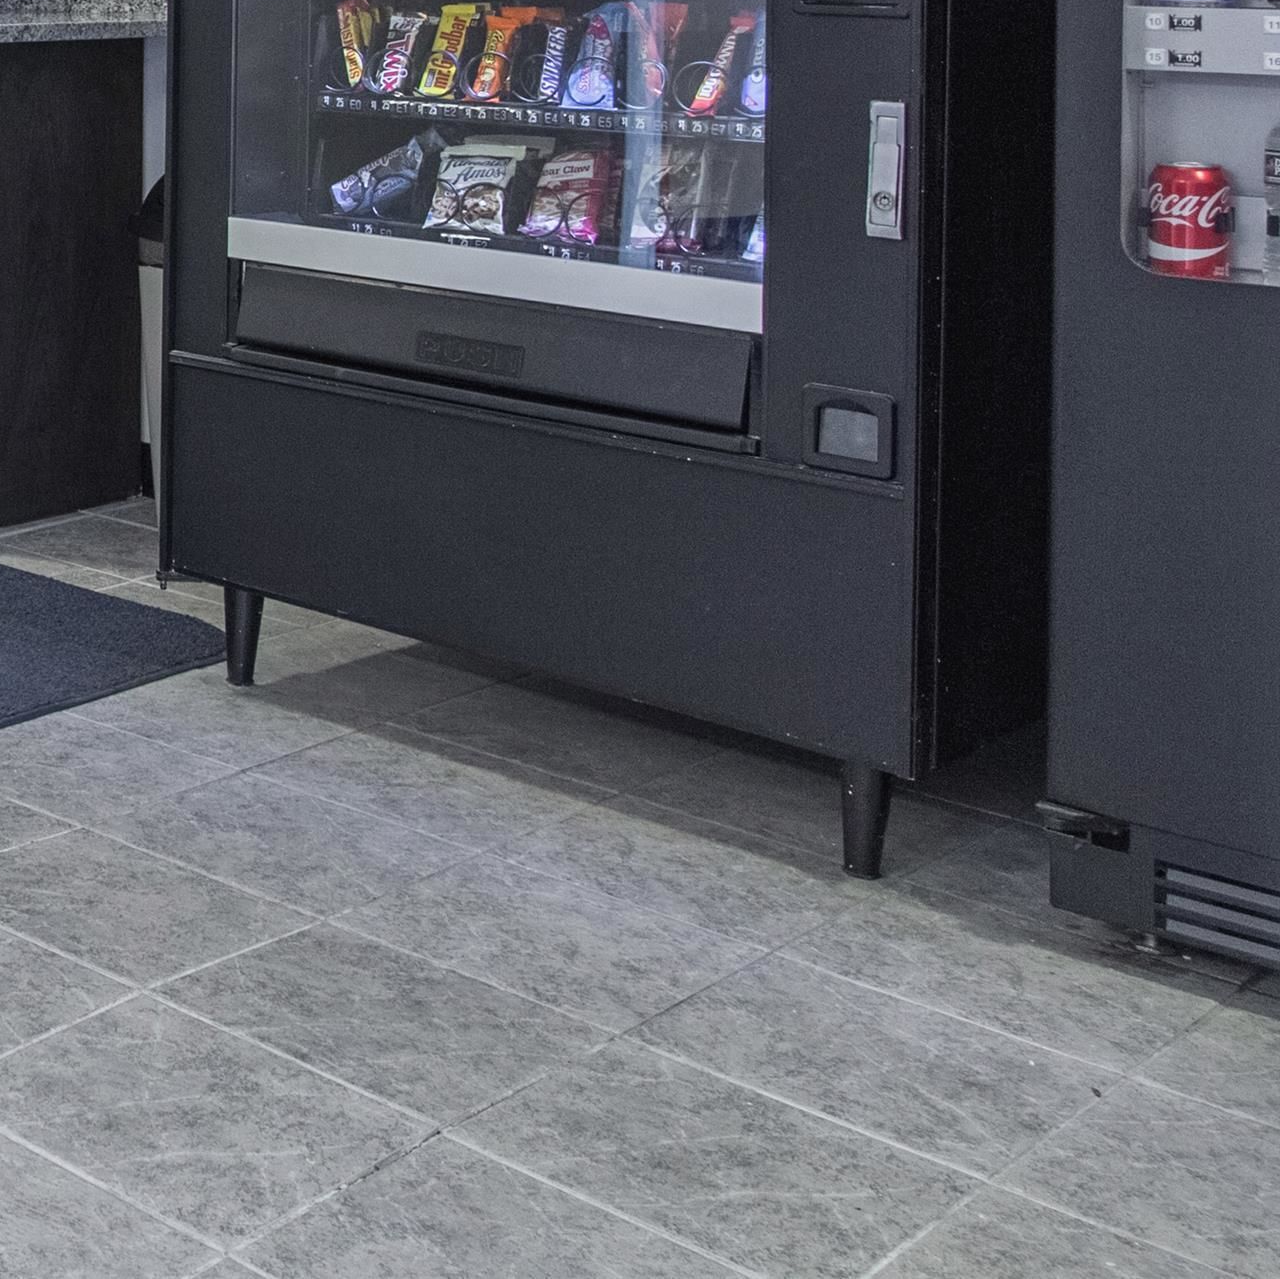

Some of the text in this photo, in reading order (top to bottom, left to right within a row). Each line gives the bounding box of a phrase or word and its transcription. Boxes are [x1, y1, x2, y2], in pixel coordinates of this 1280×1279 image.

[1149, 18, 1195, 27] 10 1.00
[1149, 52, 1199, 63] 15 1.00
[544, 113, 558, 124] E4
[598, 116, 612, 128] E5
[711, 123, 726, 135] E7
[452, 165, 503, 185] Amos
[563, 165, 591, 174] Claw
[1149, 183, 1231, 228] Coca-C
